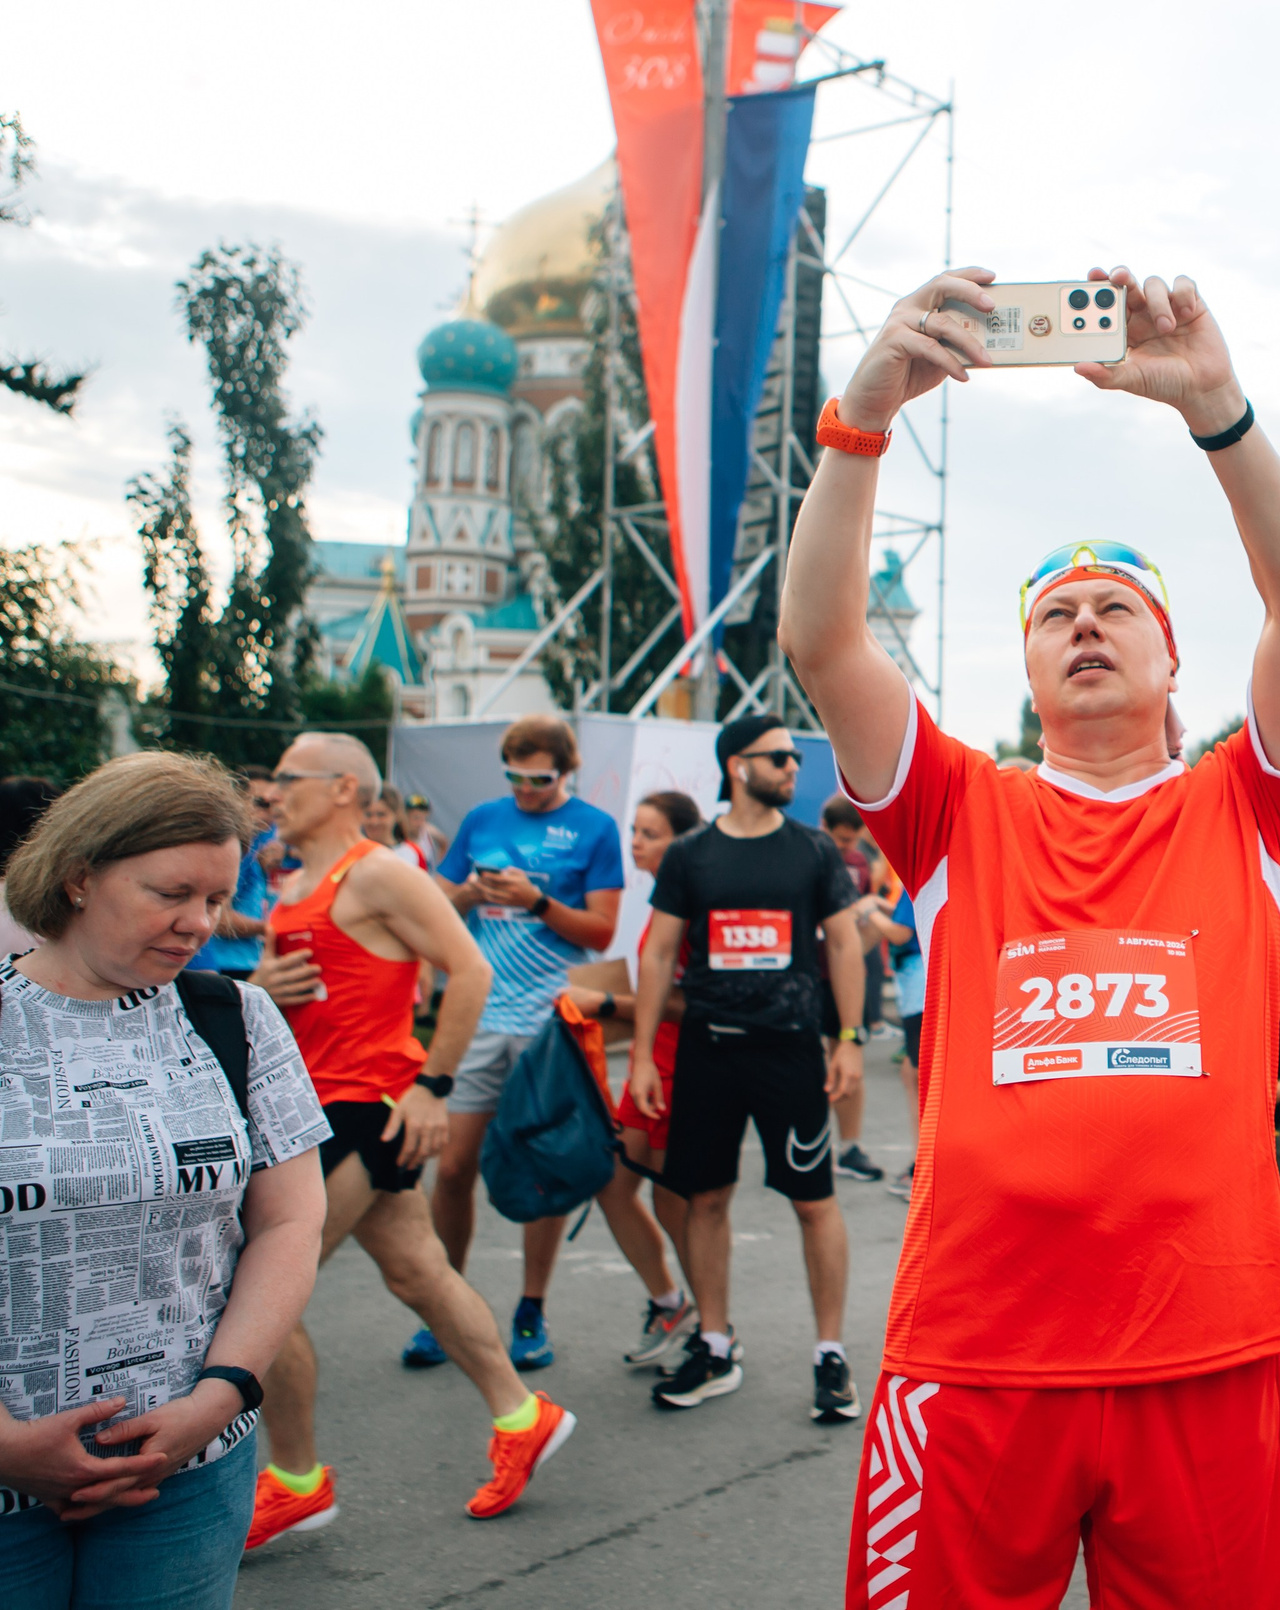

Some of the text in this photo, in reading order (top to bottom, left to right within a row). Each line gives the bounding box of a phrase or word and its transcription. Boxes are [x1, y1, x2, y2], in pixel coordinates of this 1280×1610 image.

[1126, 937, 1165, 948] АВГУСТА
[1166, 940, 1186, 949] 2024
[1019, 972, 1170, 1024] 2873
[1118, 1054, 1168, 1065] Следопыт
[51, 1050, 72, 1109] FASHION
[92, 1068, 154, 1080] Boho-Chic
[88, 1089, 117, 1101] What
[139, 1113, 157, 1144] BEAUTY
[149, 1145, 165, 1197] EXPECTANT
[177, 1163, 223, 1194] MY
[164, 1191, 211, 1203] INSPIRED
[148, 1210, 160, 1225] F
[116, 1327, 175, 1346] You Guide to
[107, 1336, 175, 1360] Boho-Chic
[65, 1327, 80, 1402] FASHION
[90, 1362, 121, 1375] Voyage
[100, 1370, 130, 1385] What
[105, 1383, 114, 1391] to
[116, 1376, 138, 1388] know
